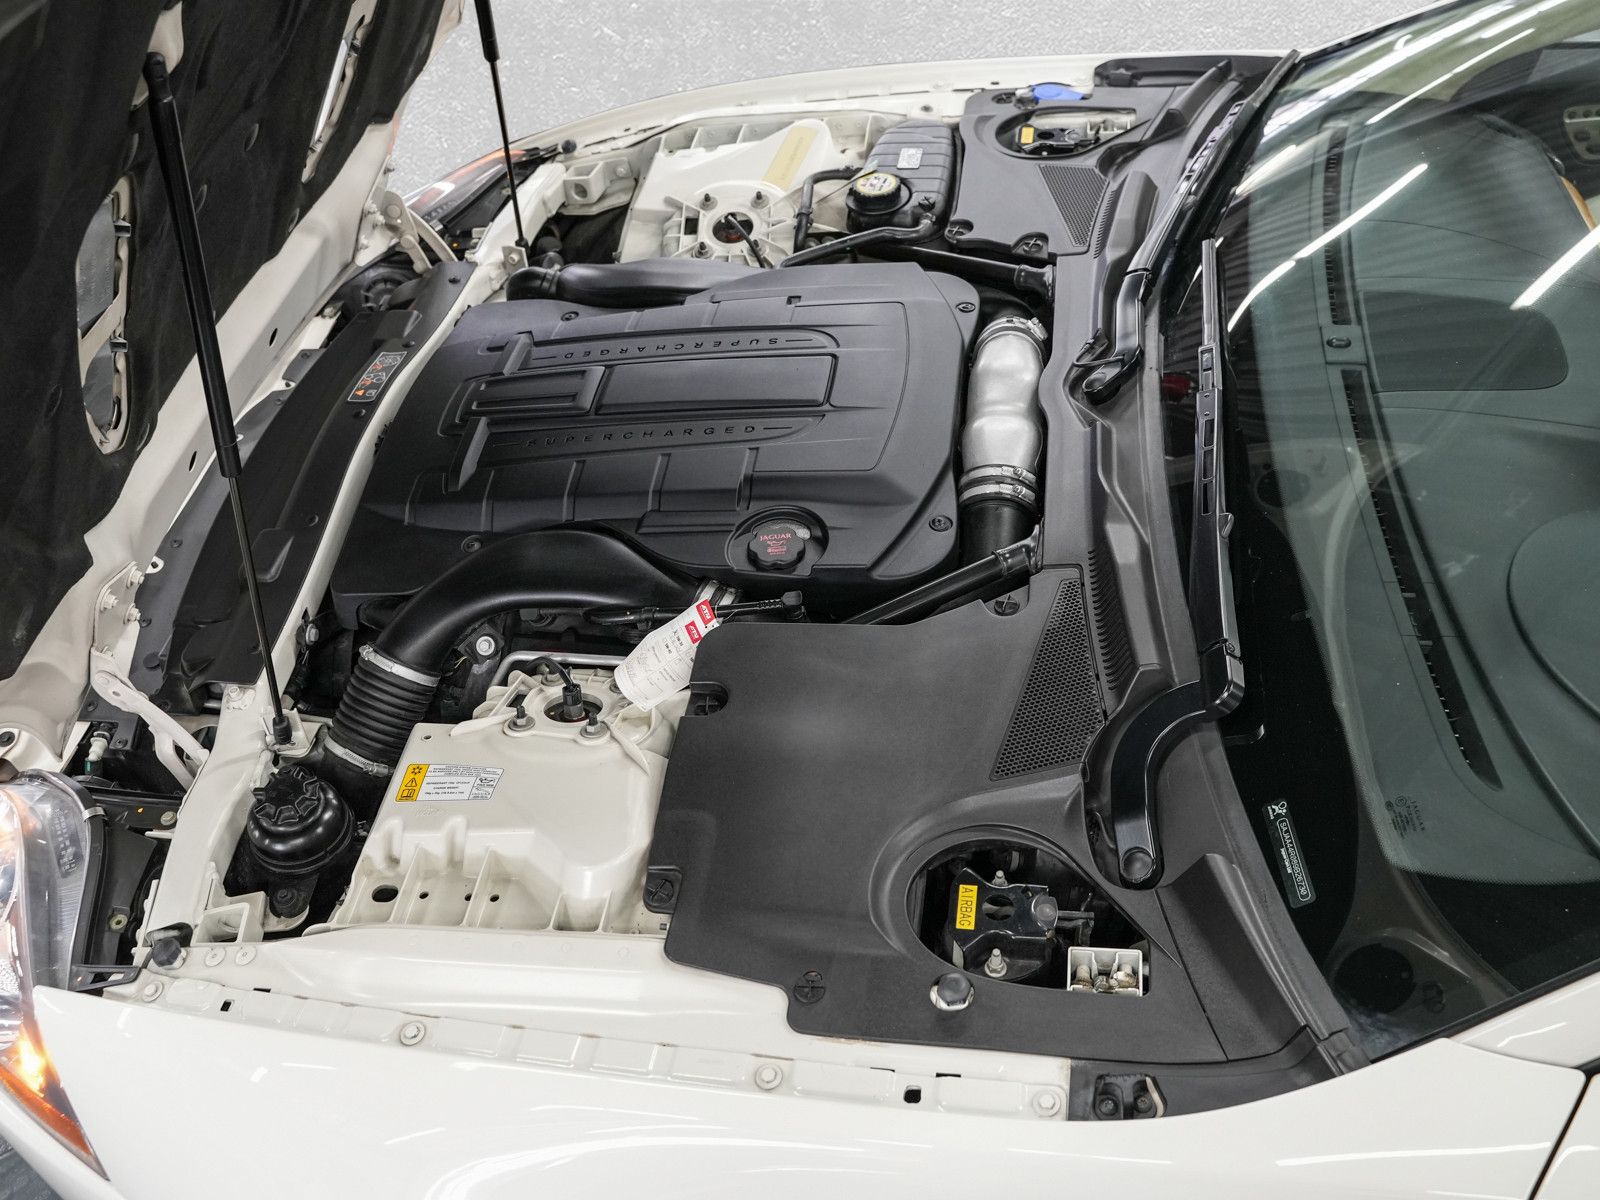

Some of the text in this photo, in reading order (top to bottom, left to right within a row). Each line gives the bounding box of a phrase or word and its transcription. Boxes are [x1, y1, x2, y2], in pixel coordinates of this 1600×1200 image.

[564, 337, 779, 359] SUPERCHARGED
[525, 425, 756, 447] SUPERCHARGED
[760, 532, 792, 541] JAGUAR
[959, 886, 974, 927] AIRBAG
